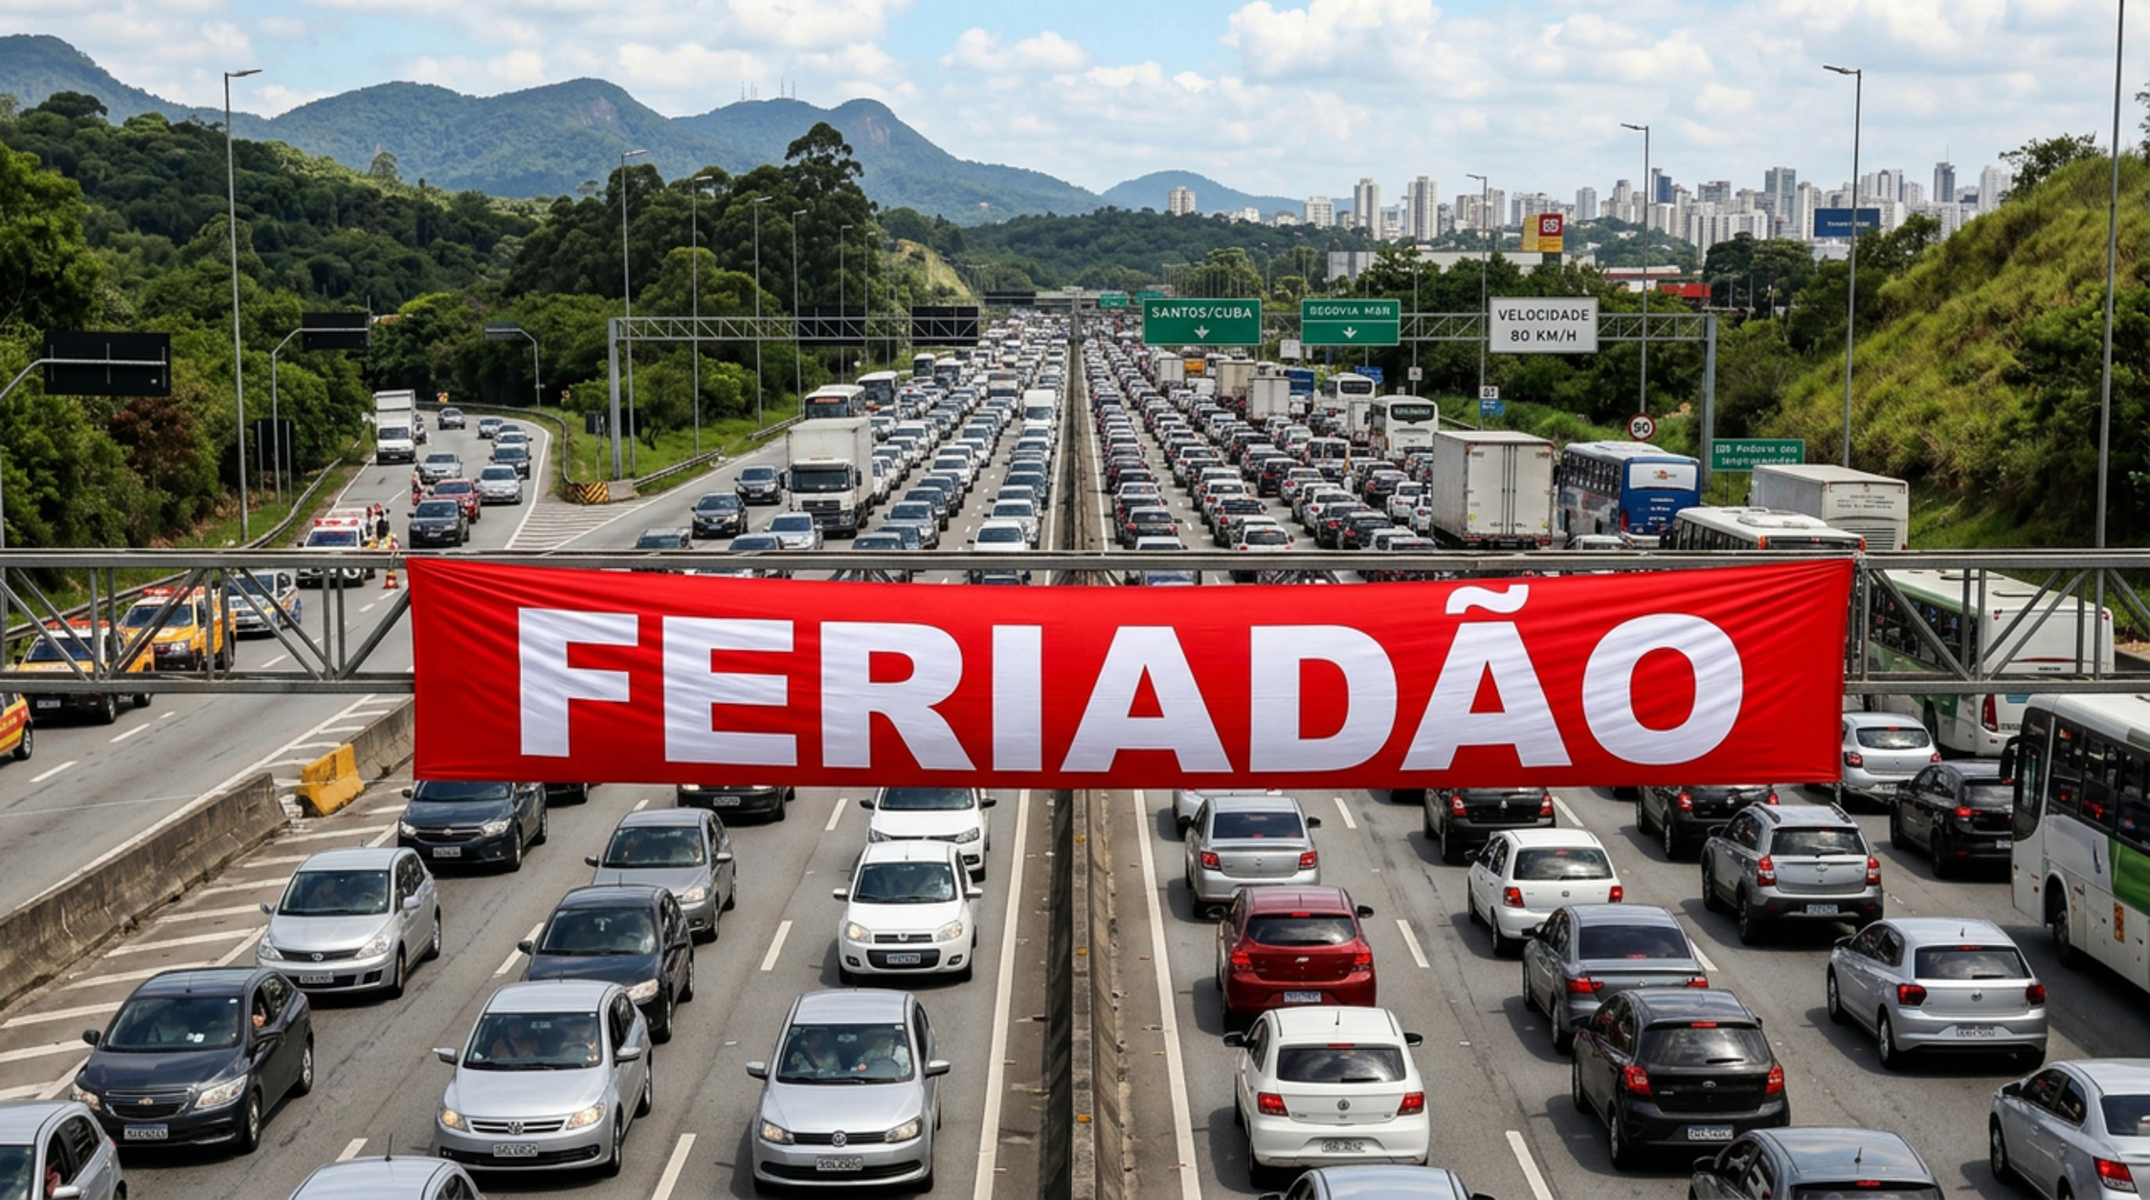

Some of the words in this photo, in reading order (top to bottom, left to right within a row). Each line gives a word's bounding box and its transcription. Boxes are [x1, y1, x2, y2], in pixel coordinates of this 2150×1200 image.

[1151, 306, 1253, 319] SANTOS/CUBA
[1498, 309, 1590, 321] VELOCIDADE
[1510, 329, 1531, 342] 80
[1536, 329, 1577, 342] KM/H
[1633, 421, 1650, 434] 90
[518, 583, 1744, 773] FERIADÃO
